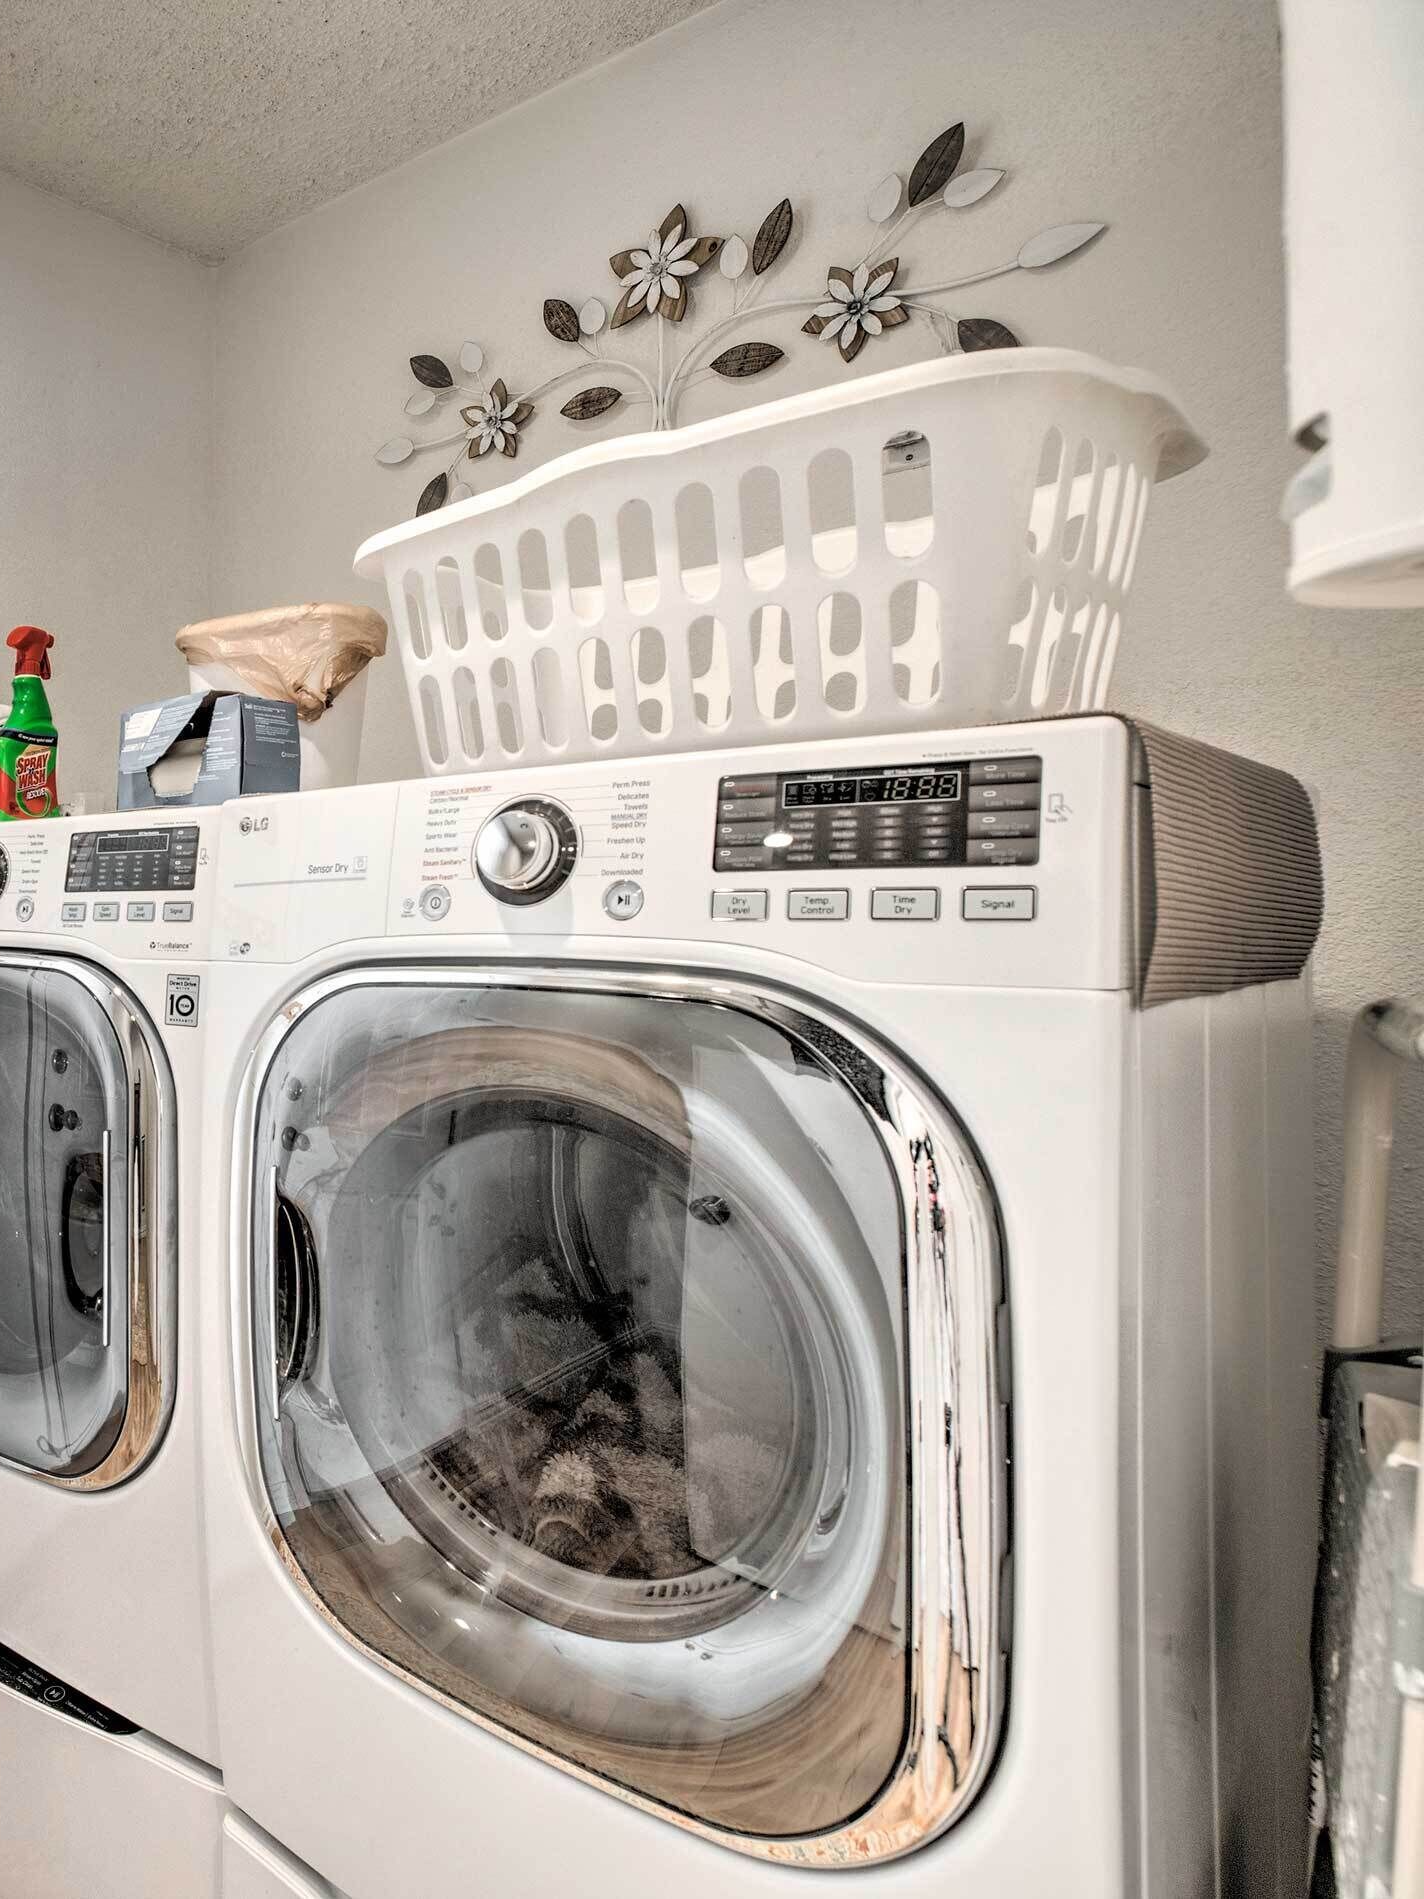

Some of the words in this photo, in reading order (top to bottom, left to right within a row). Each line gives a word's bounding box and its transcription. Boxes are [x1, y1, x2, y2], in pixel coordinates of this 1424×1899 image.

[17, 753, 49, 774] SPRAY
[18, 769, 46, 789] WASH
[631, 780, 651, 788] Press
[883, 774, 956, 800] 18:88
[618, 792, 649, 801] Delicates
[624, 803, 648, 811] Towels
[253, 817, 269, 832] LG
[611, 822, 633, 830] Speed
[634, 820, 647, 828] Dry
[636, 837, 646, 845] Up
[631, 852, 644, 860] Dry
[308, 864, 334, 875] Sensor
[335, 863, 349, 874] Dry
[601, 868, 643, 877] Downloaded
[731, 897, 747, 906] Dry
[892, 895, 916, 904] Time
[727, 904, 750, 914] Level
[800, 904, 835, 914] Control
[894, 905, 912, 915] Dry
[980, 899, 1015, 911] Signal
[169, 993, 195, 1017] 10
